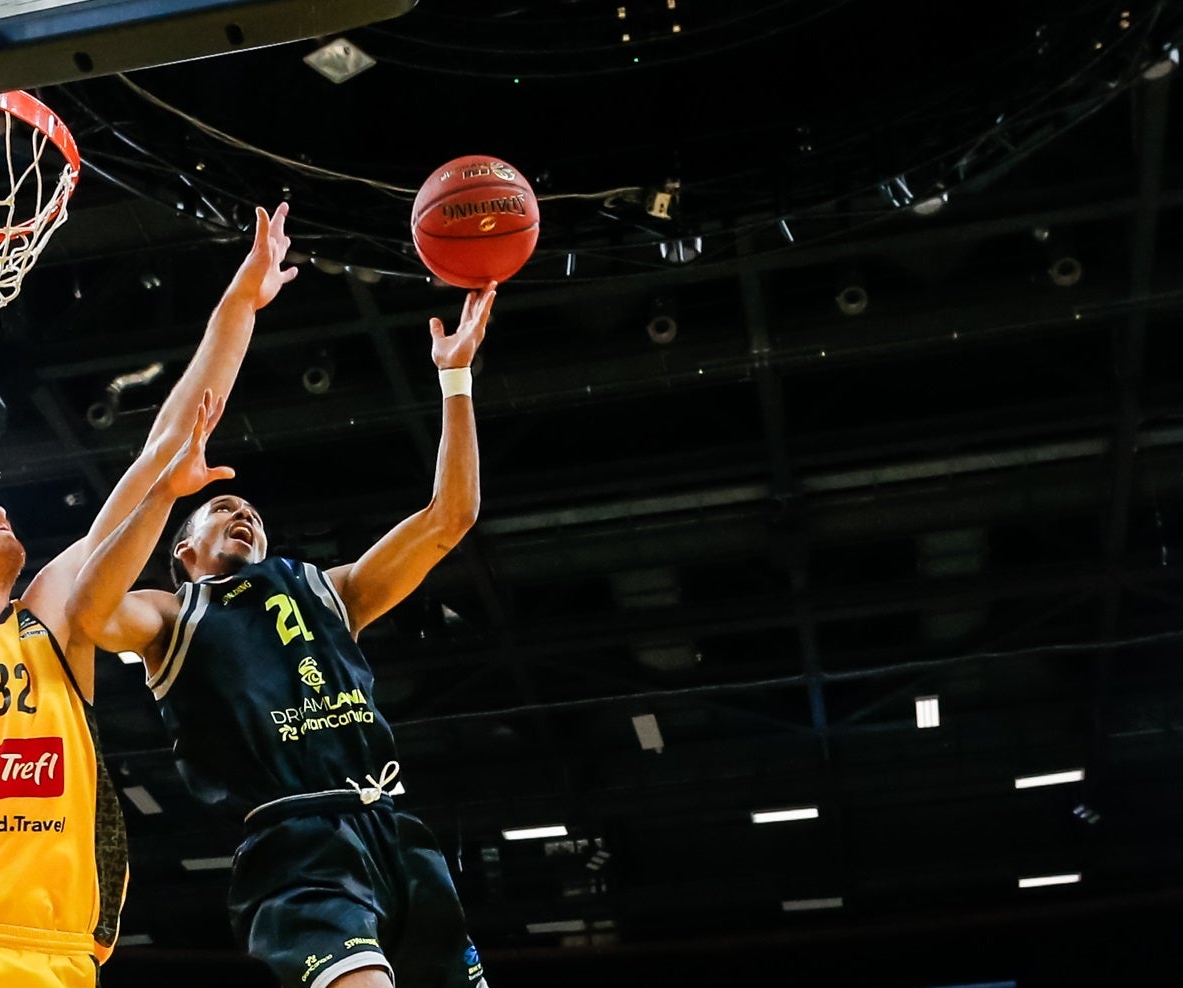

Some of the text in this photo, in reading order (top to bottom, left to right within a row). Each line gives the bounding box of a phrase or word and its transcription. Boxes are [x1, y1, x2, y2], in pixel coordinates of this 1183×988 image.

[441, 194, 525, 220] SPALDING
[264, 593, 315, 646] 21
[0, 752, 59, 786] Trefl
